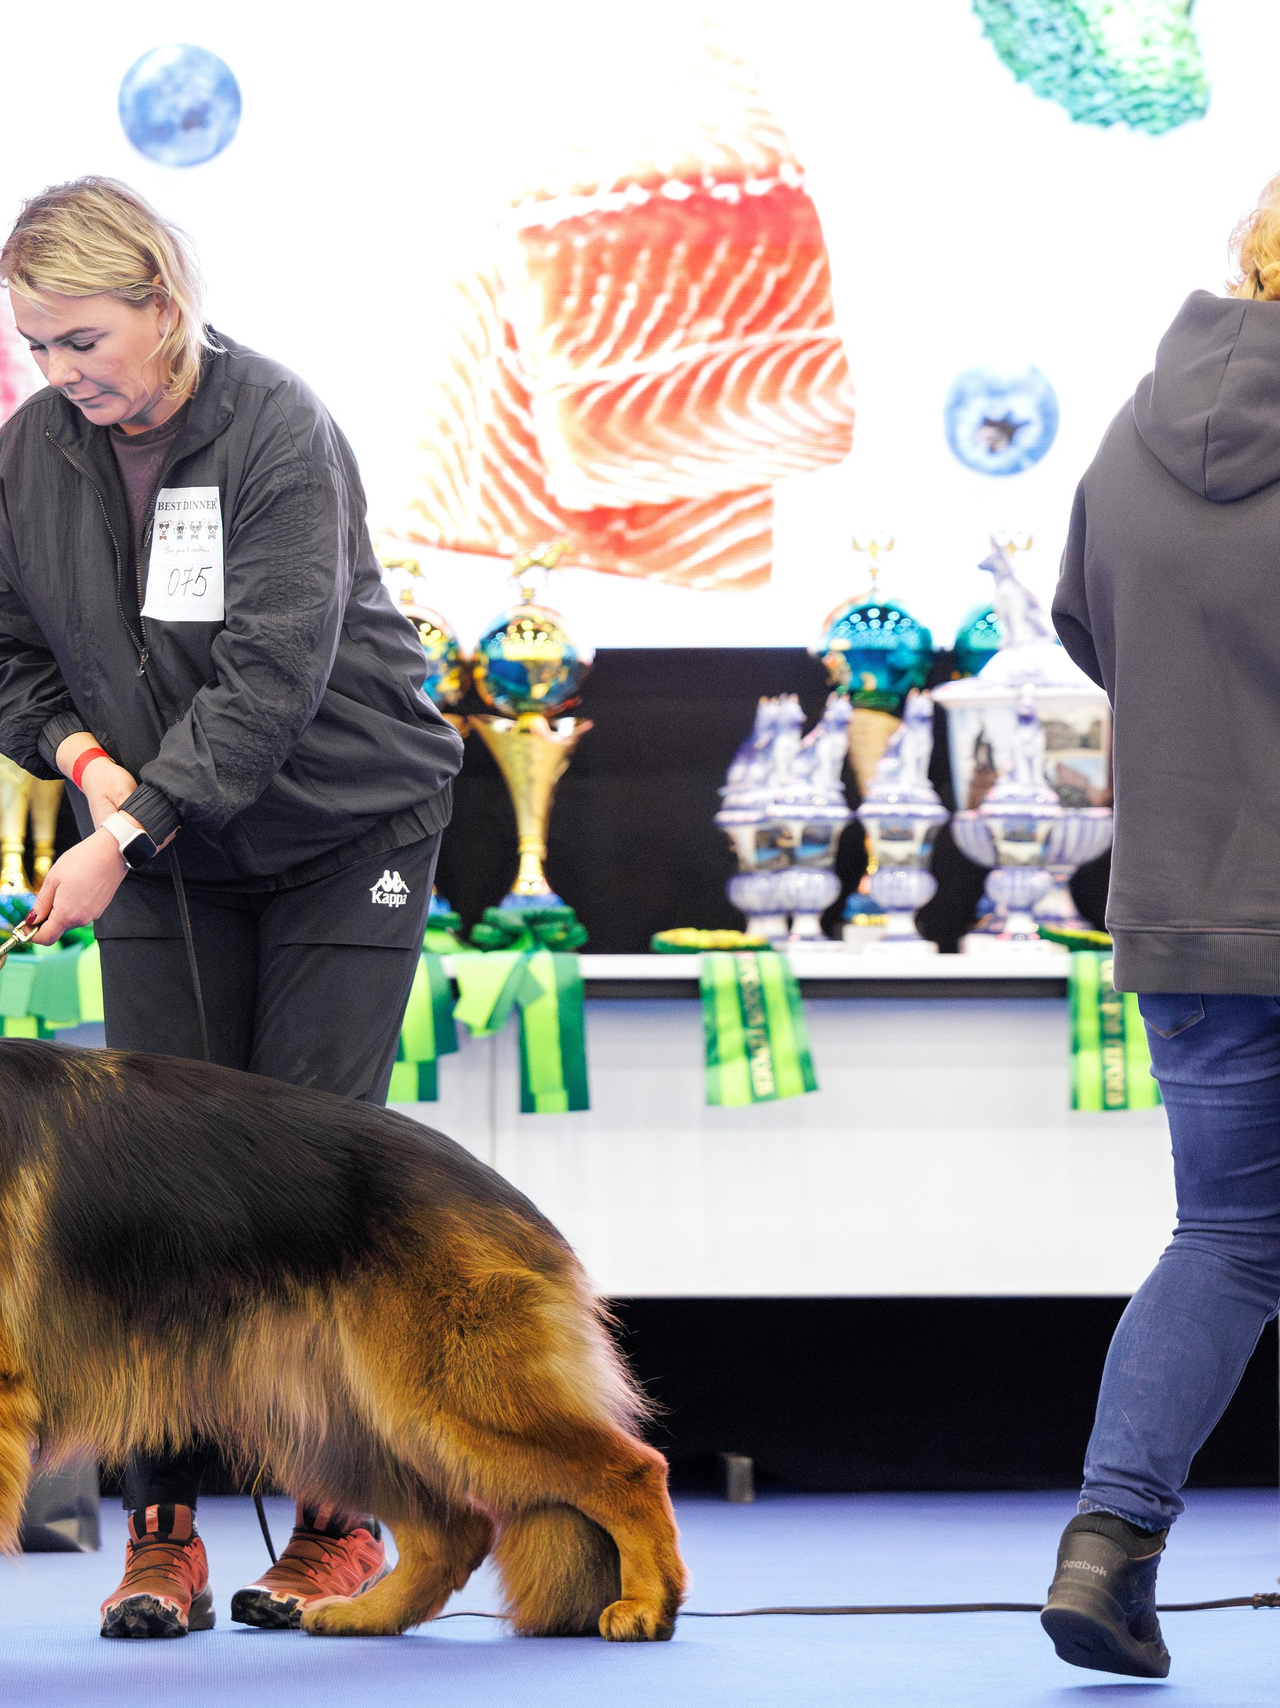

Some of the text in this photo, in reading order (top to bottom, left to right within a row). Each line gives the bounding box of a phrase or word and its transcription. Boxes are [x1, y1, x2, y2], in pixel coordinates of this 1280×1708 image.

[158, 500, 217, 511] BEST DINNER
[168, 566, 213, 597] 075
[372, 891, 408, 908] Kappa
